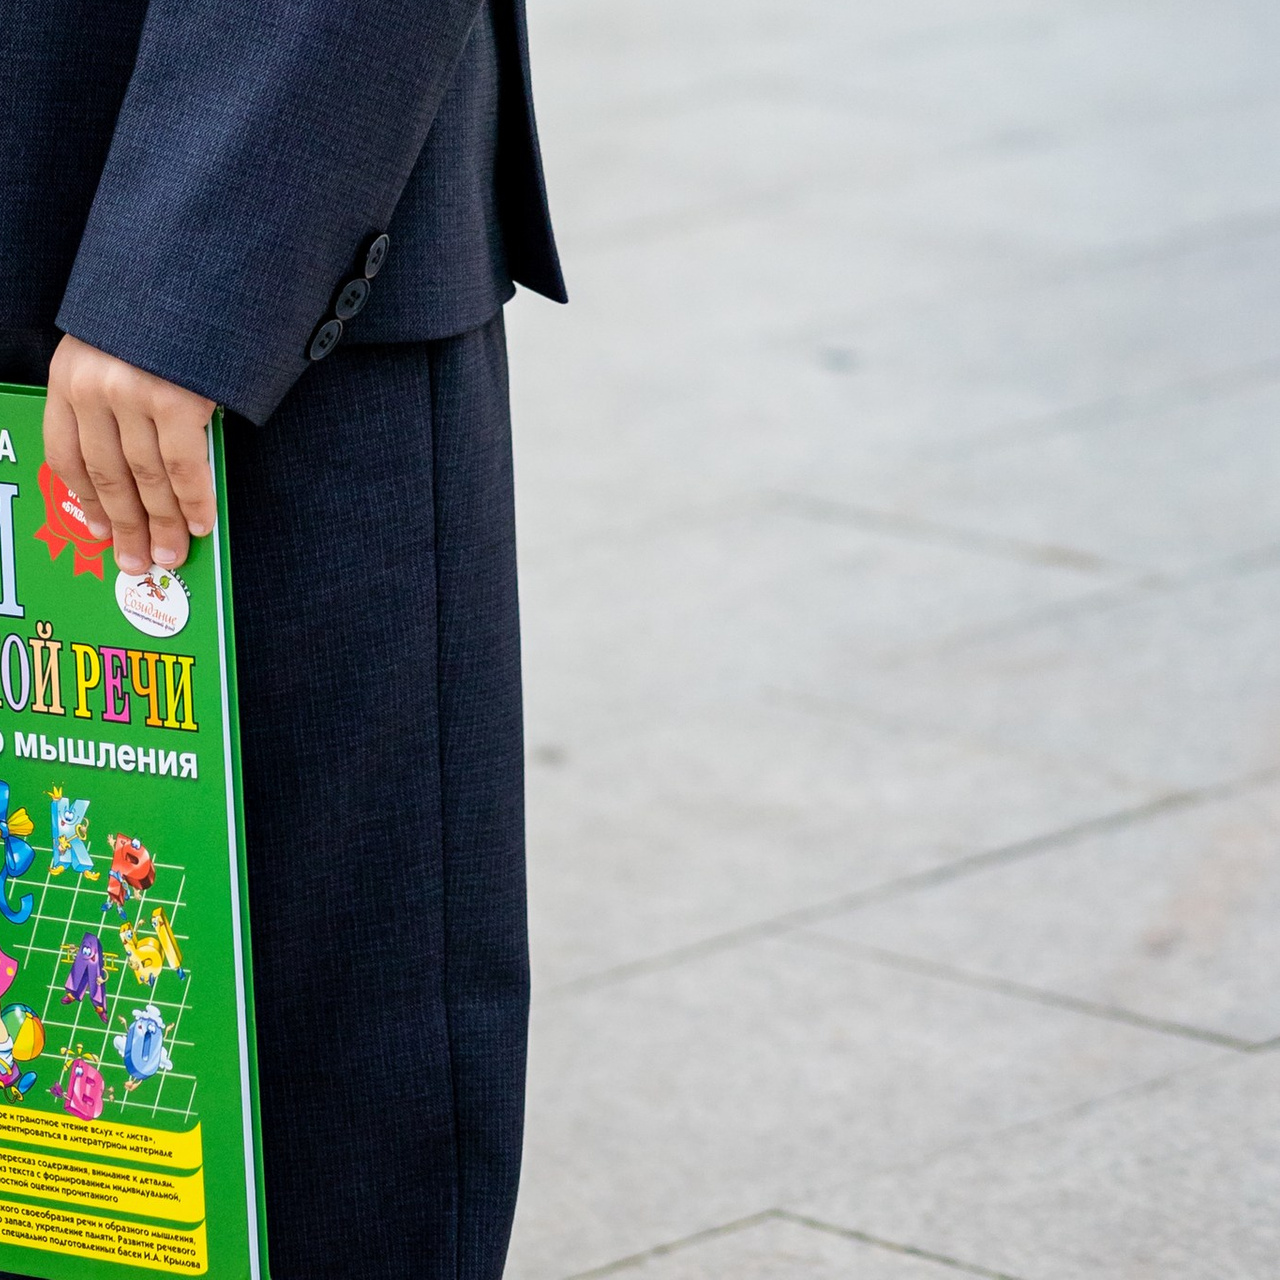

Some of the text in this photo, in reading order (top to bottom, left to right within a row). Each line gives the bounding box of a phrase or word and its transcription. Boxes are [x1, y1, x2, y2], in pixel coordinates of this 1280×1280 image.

[71, 641, 199, 732] РЕЧИ
[14, 731, 198, 779] мышления
[16, 1115, 58, 1128] грамотное
[62, 1122, 88, 1132] чтение
[90, 1127, 112, 1138] вслух
[126, 1133, 156, 1144] листа»,
[70, 1135, 128, 1151] литературном
[129, 1144, 173, 1158] материале
[8, 1166, 35, 1177] текста
[43, 1171, 111, 1190] формированием
[112, 1184, 181, 1202] индивидуальной,
[30, 1181, 60, 1193] оценки
[62, 1188, 118, 1203] прочитанного
[38, 1159, 90, 1175] содержания,
[92, 1168, 130, 1180] внимание
[140, 1177, 175, 1189] деталям.
[4, 1216, 34, 1229] запаса,
[35, 1223, 82, 1237] укрепление
[85, 1230, 116, 1242] памяти.
[118, 1235, 154, 1249] Развитие
[156, 1243, 196, 1257] речевого
[21, 1208, 74, 1224] своеобразия
[76, 1218, 96, 1228] речи
[105, 1222, 150, 1236] образного
[151, 1231, 196, 1245] мышления,
[2, 1227, 48, 1243] специально
[50, 1236, 116, 1254] подготовленных
[118, 1246, 142, 1259] басен
[144, 1250, 161, 1262] И.А.
[164, 1254, 201, 1270] Крылова
